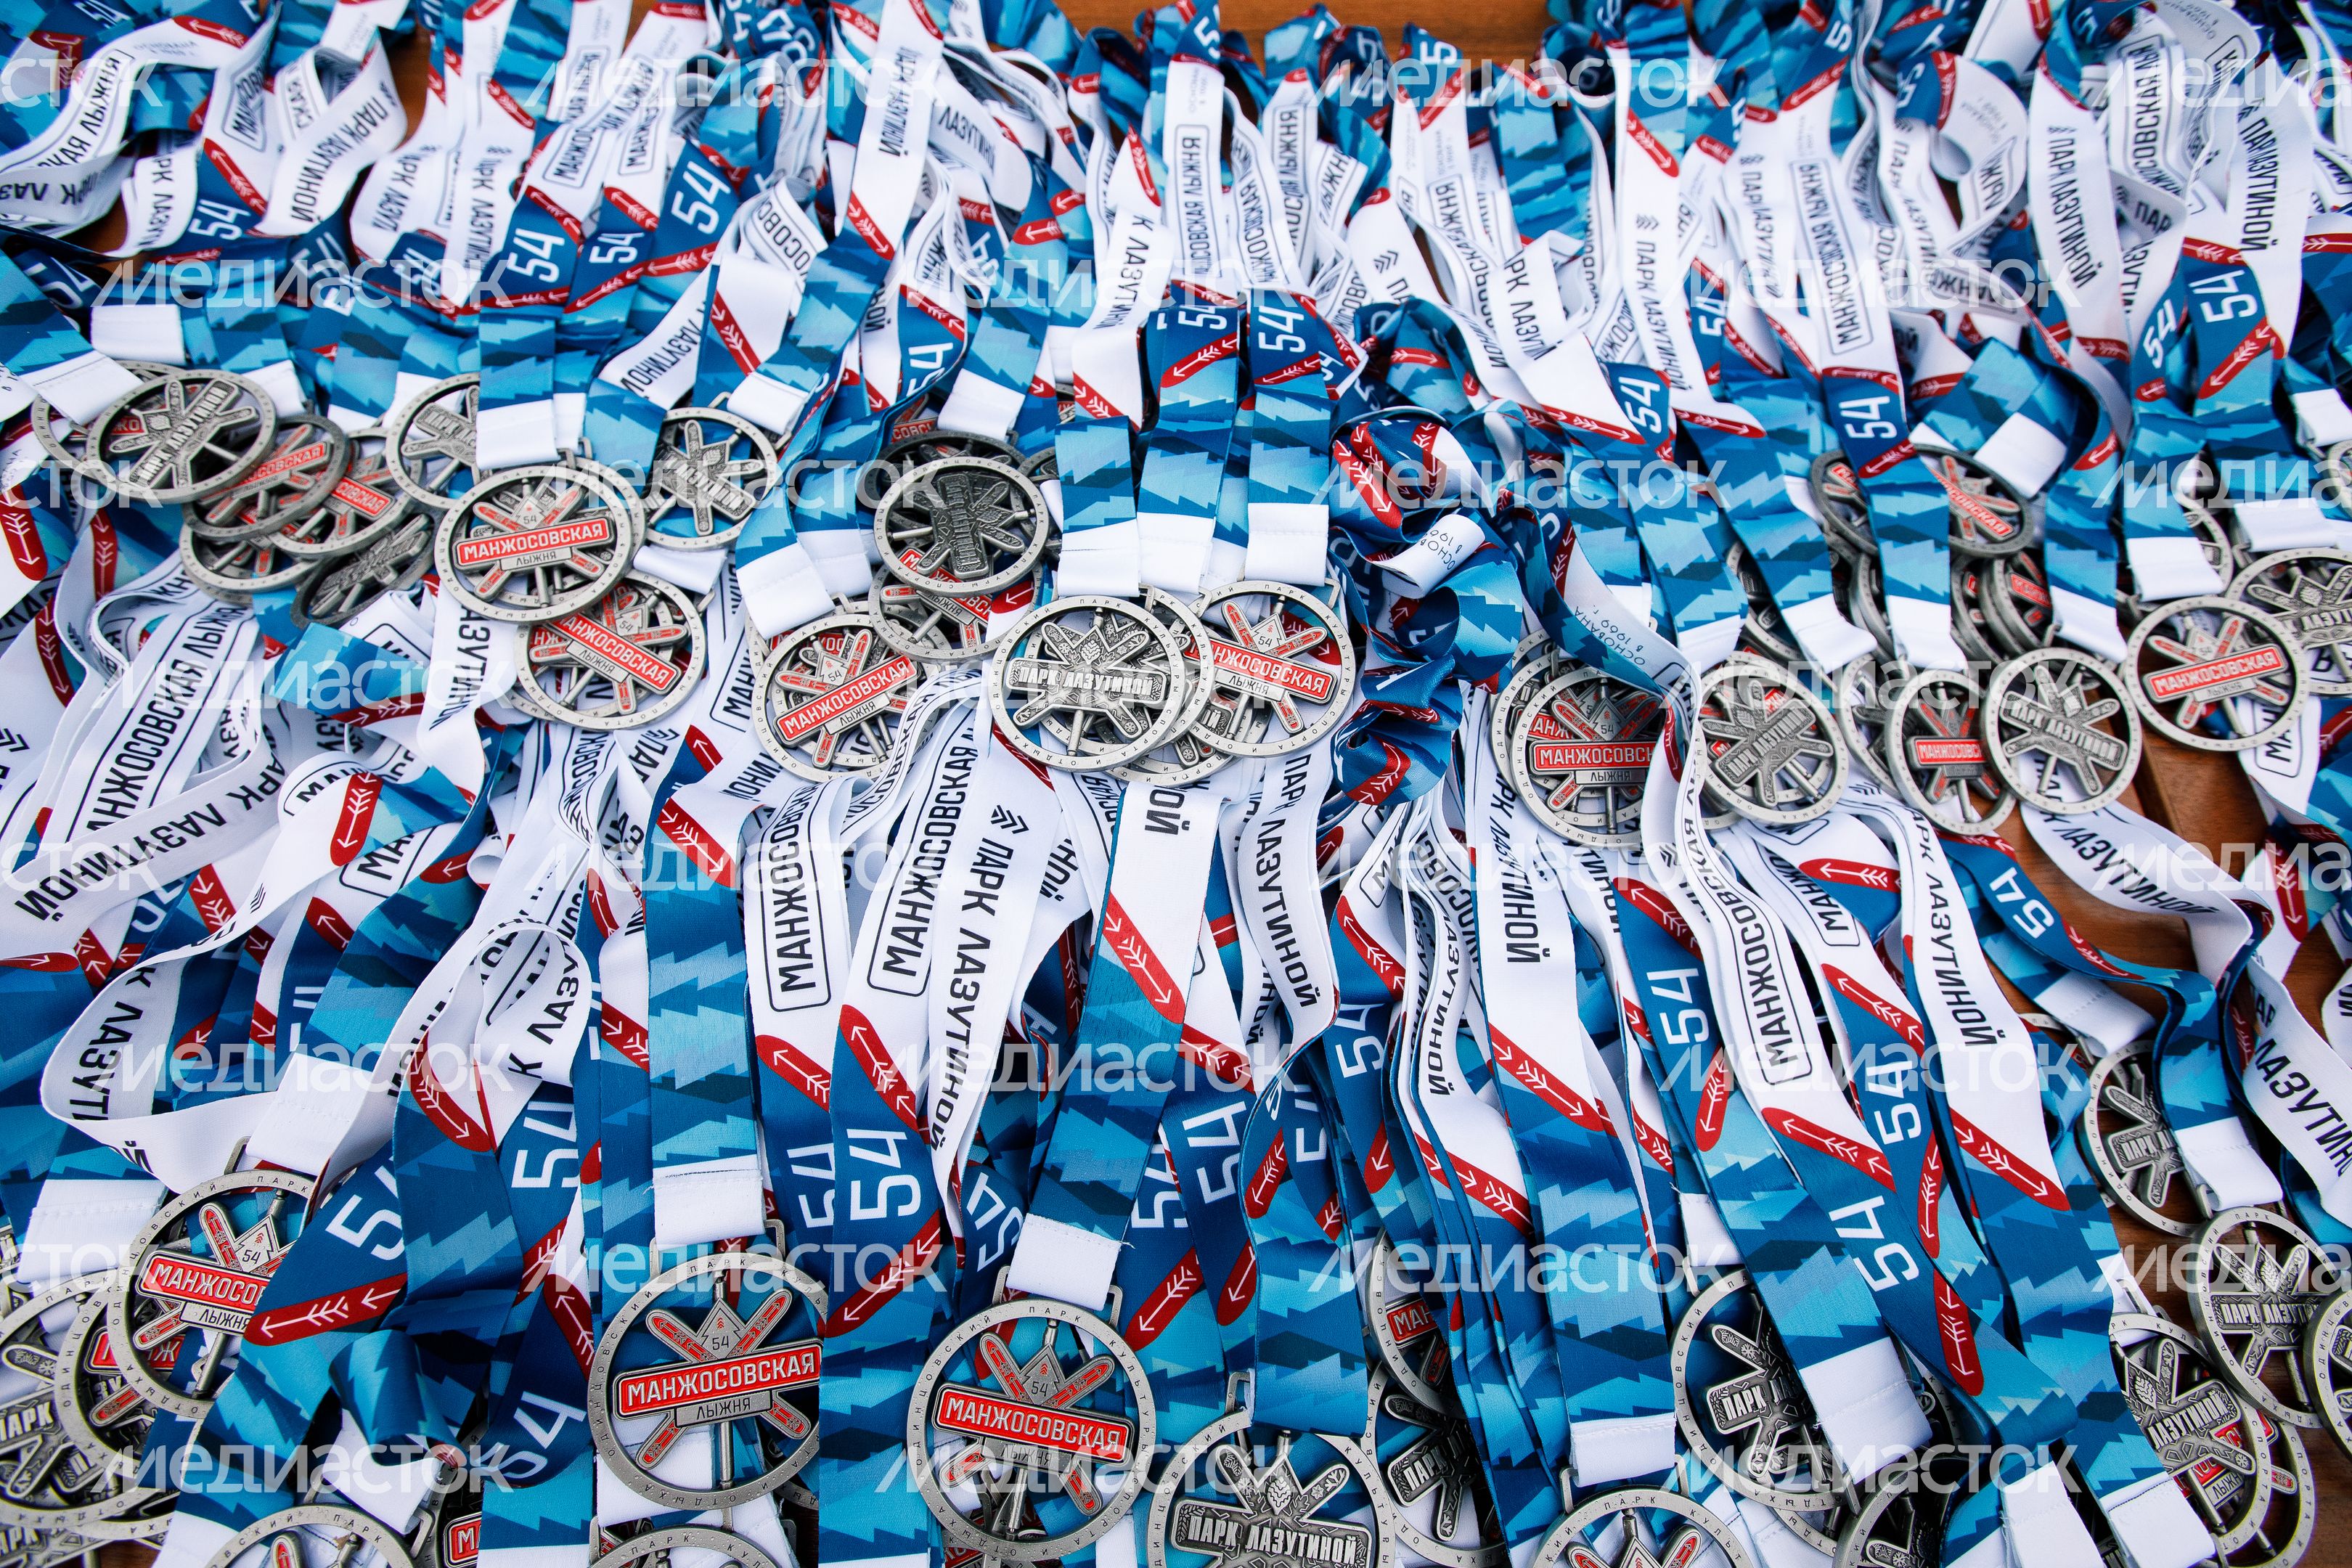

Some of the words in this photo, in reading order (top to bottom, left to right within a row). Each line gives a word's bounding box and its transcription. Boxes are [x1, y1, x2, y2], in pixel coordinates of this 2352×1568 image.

[187, 198, 252, 241] 54
[672, 161, 730, 234] 54
[506, 228, 565, 283] 54
[589, 232, 645, 264] 54
[2189, 269, 2258, 324] 54
[1259, 306, 1304, 352] 54
[1620, 376, 1662, 433] 54
[1839, 396, 1898, 439] 54
[463, 525, 605, 561] МАНЖОСОВСКАЯ
[1079, 598, 1122, 609] ПАРК
[785, 662, 908, 734] МАНЖОСОВСКАЯ
[86, 660, 207, 830] НЖОСОВСКАЯ
[226, 755, 285, 812] АРК
[15, 802, 226, 922] ЛАЗУТИНОЙ
[962, 838, 1014, 917] ПАРК
[1255, 819, 1322, 1006] ЛАЗУТИНОЙ
[1988, 868, 2054, 940] 54
[1925, 873, 2006, 1048] ЛАЗУТИНОЙ
[1647, 968, 1709, 1045] 54
[931, 927, 992, 1152] ЛАЗУТИНОЙ
[1867, 1061, 1922, 1146] 54
[847, 1128, 920, 1220] 54
[242, 1250, 261, 1264] 54
[1829, 1196, 1920, 1291] 54
[1028, 1306, 1082, 1323] ПАРК
[711, 1337, 730, 1350] 54
[627, 1352, 816, 1407] МАНЖОСОВСКАЯ
[1031, 1381, 1048, 1397] 54
[696, 1398, 752, 1420] ЛЫЖНЯ
[945, 1397, 1121, 1454] МАНЖОСОВСКАЯ
[1604, 1495, 1657, 1512] ПАРК
[630, 1535, 690, 1556] ПАРК
[1188, 1516, 1239, 1546] ПАРК
[1247, 1524, 1359, 1568] ЛАЗУТИНОЙ
